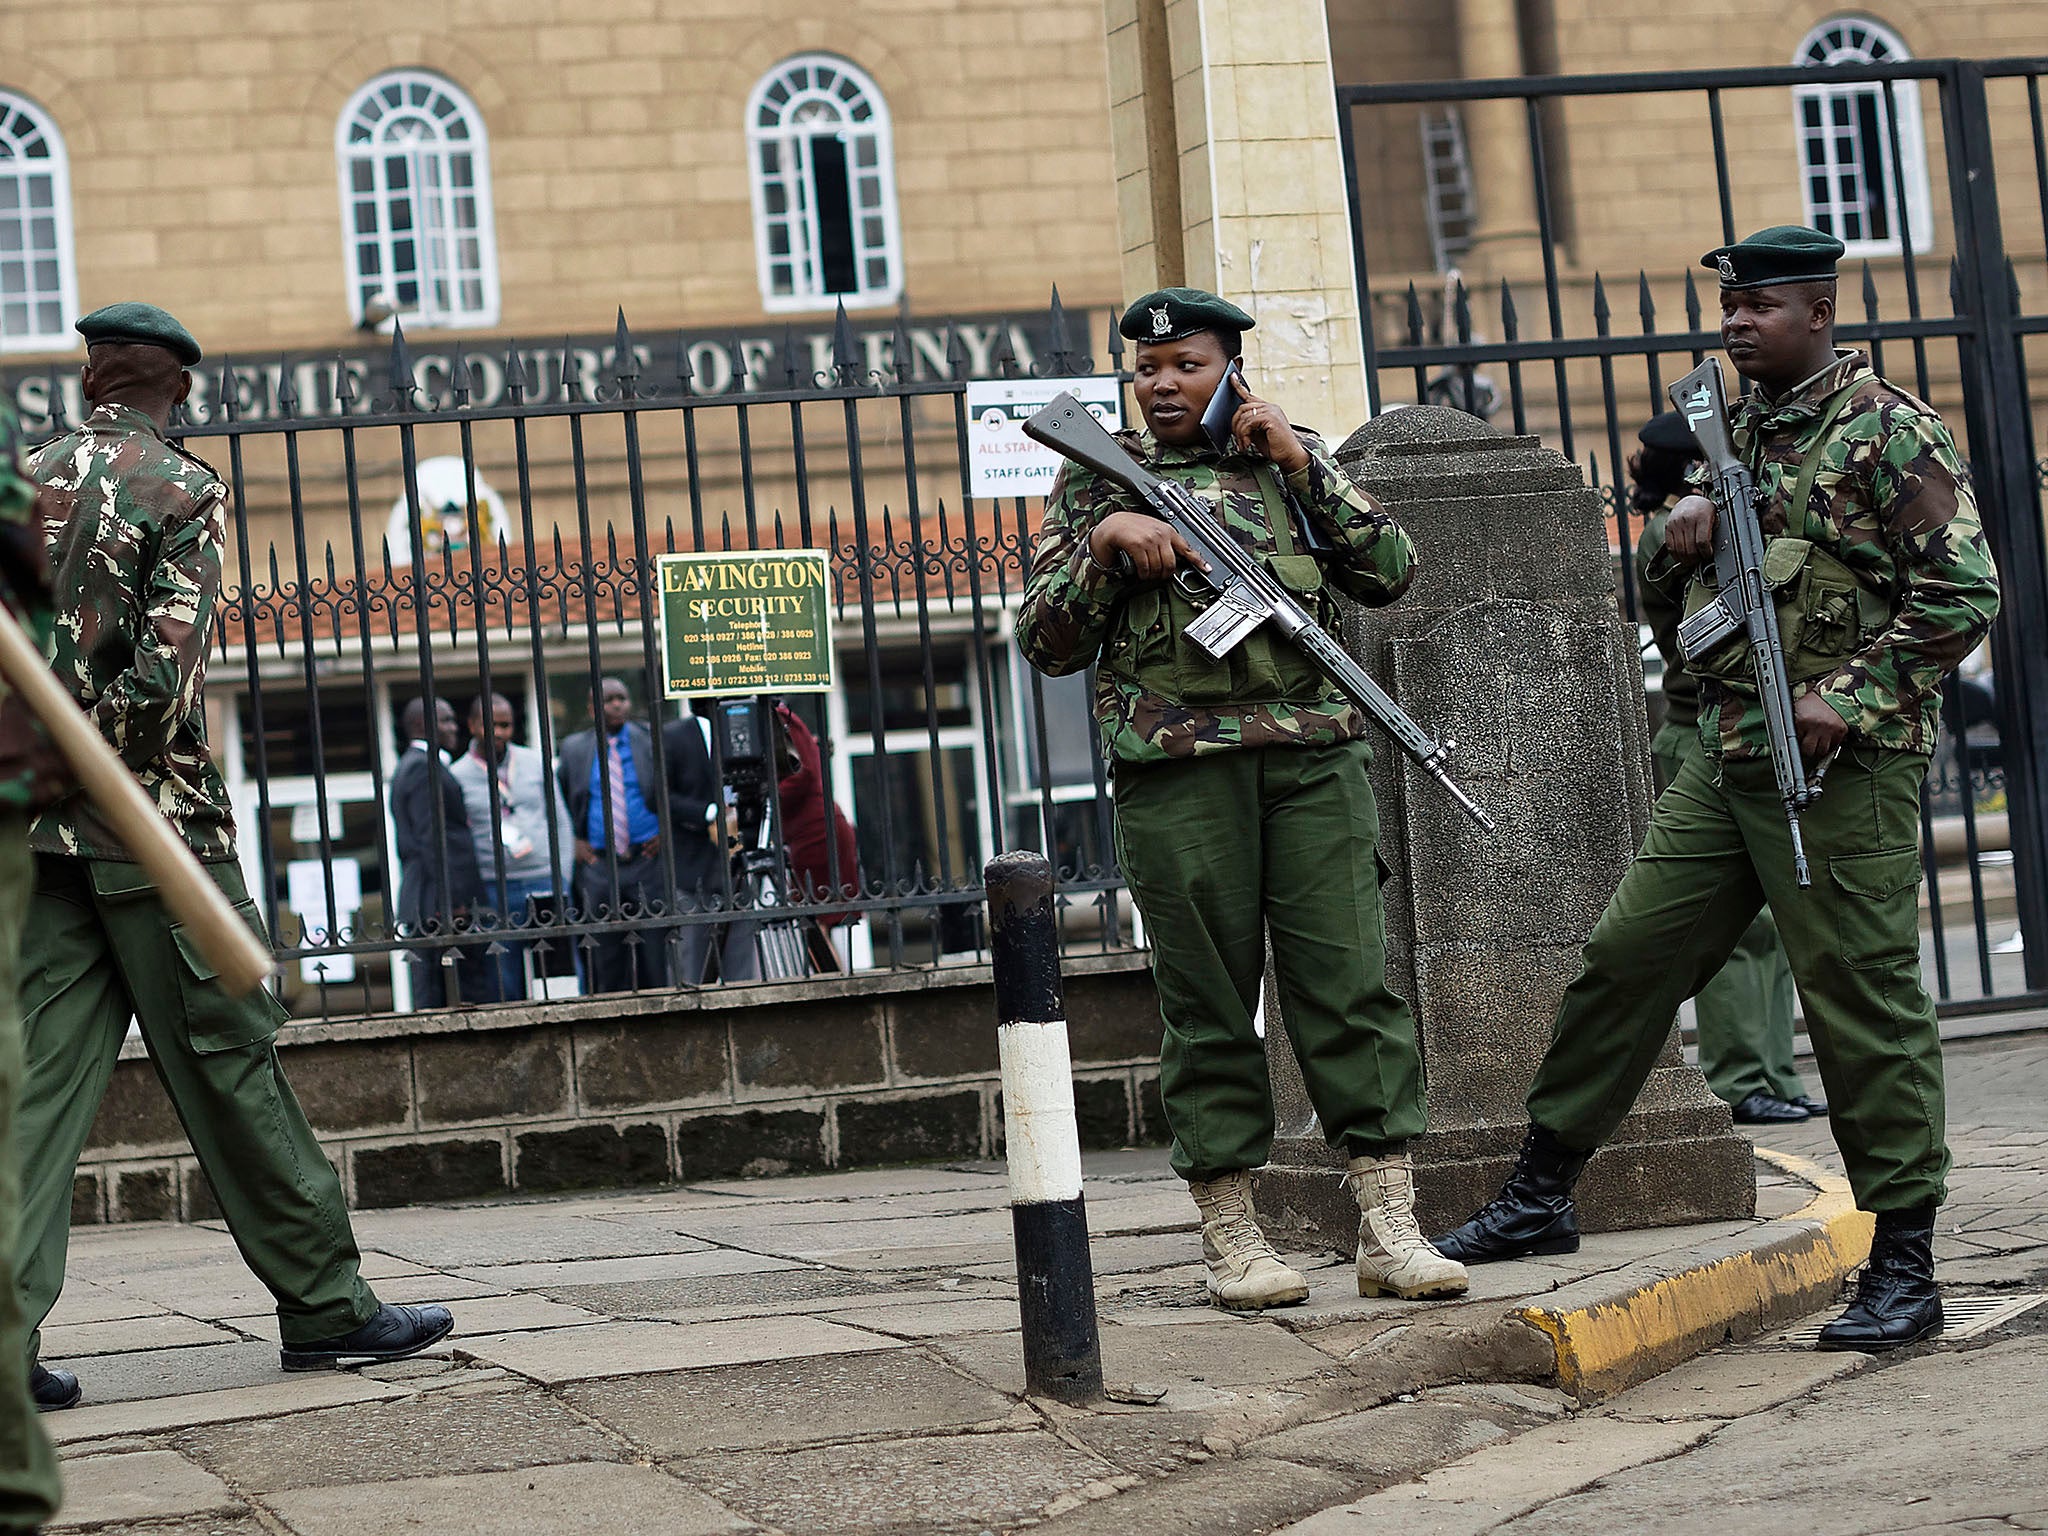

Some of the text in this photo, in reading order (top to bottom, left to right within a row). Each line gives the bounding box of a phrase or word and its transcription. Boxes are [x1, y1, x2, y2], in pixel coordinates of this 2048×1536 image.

[17, 358, 373, 433] SUREME
[686, 338, 774, 396] OF
[979, 443, 1001, 454] ALL
[1005, 442, 1040, 454] STAFF
[984, 466, 1055, 479] STAFF GATE
[663, 561, 824, 593] LAVINGTON
[688, 595, 804, 618] SECURITY
[684, 634, 699, 643] 020
[689, 656, 704, 665] 020
[738, 663, 767, 673] Mobile:
